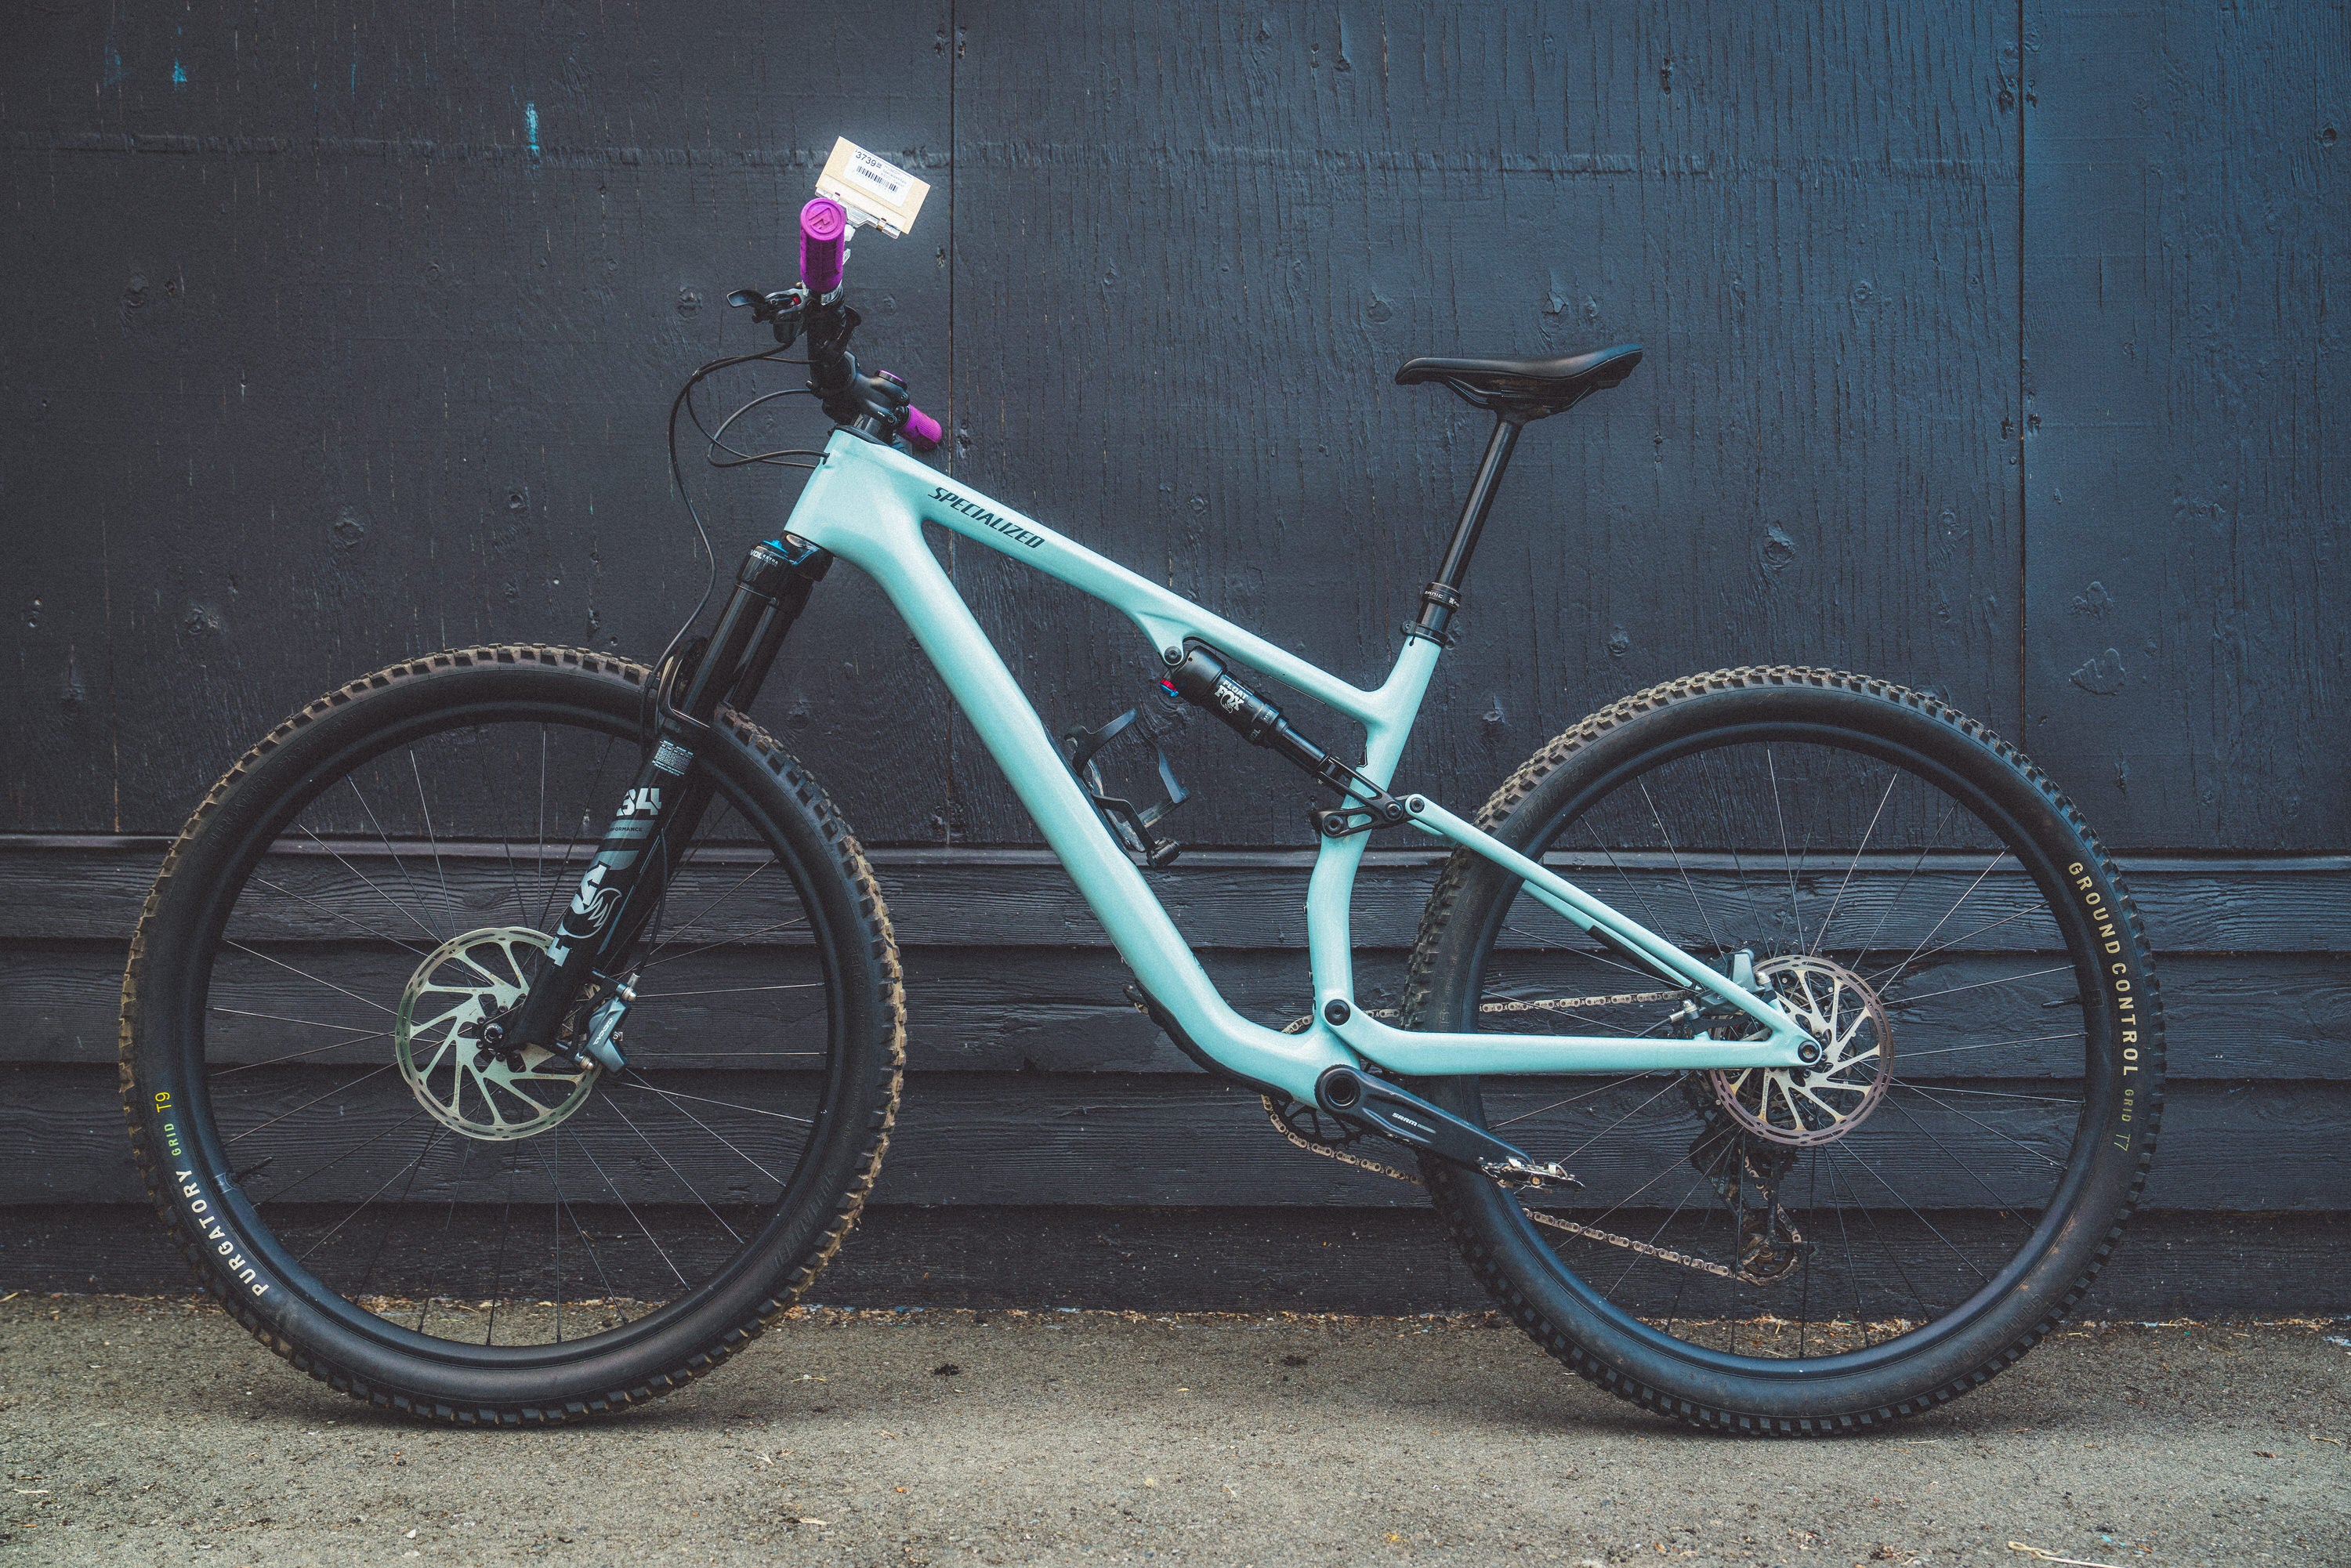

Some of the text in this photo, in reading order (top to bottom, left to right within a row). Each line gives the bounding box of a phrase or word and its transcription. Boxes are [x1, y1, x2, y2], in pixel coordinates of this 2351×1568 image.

[928, 487, 1045, 549] SPECIALIZED
[1214, 685, 1244, 713] FOX
[1223, 679, 1248, 699] FLOAT
[616, 788, 662, 817] 34
[2068, 862, 2139, 1152] GROUND CONTROL GRID T7
[1392, 1112, 1418, 1127] SRAM
[155, 1092, 270, 1297] PURGATORY GRID T9
